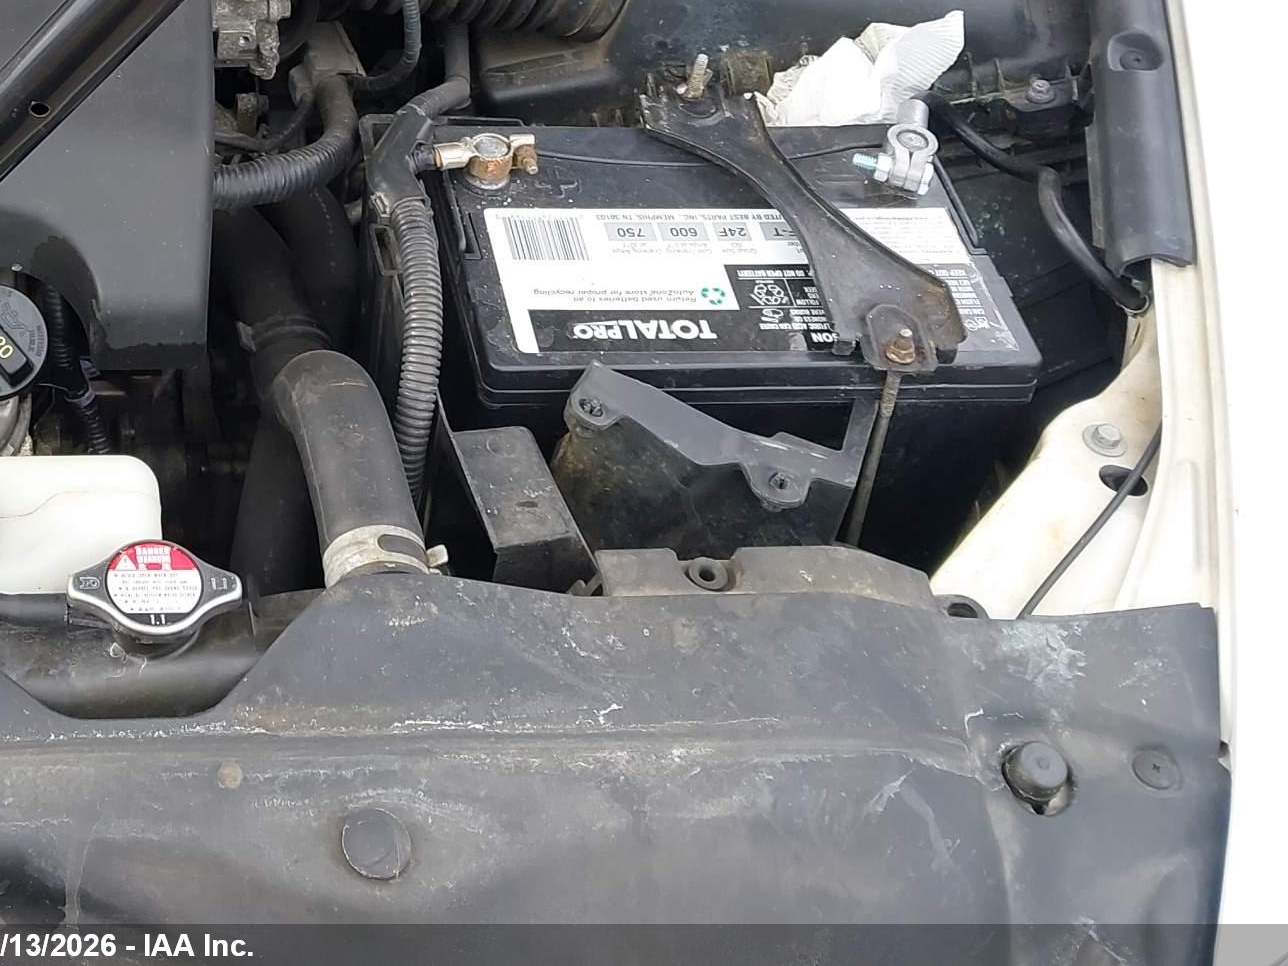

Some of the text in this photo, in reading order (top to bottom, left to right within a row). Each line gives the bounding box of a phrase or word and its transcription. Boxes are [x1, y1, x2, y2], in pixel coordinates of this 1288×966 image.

[616, 227, 646, 238] 750
[670, 227, 698, 238] 600
[718, 226, 747, 238] 24F
[574, 318, 717, 340] TOTALPRO
[811, 332, 838, 342] SON
[149, 614, 166, 625] 1.1
